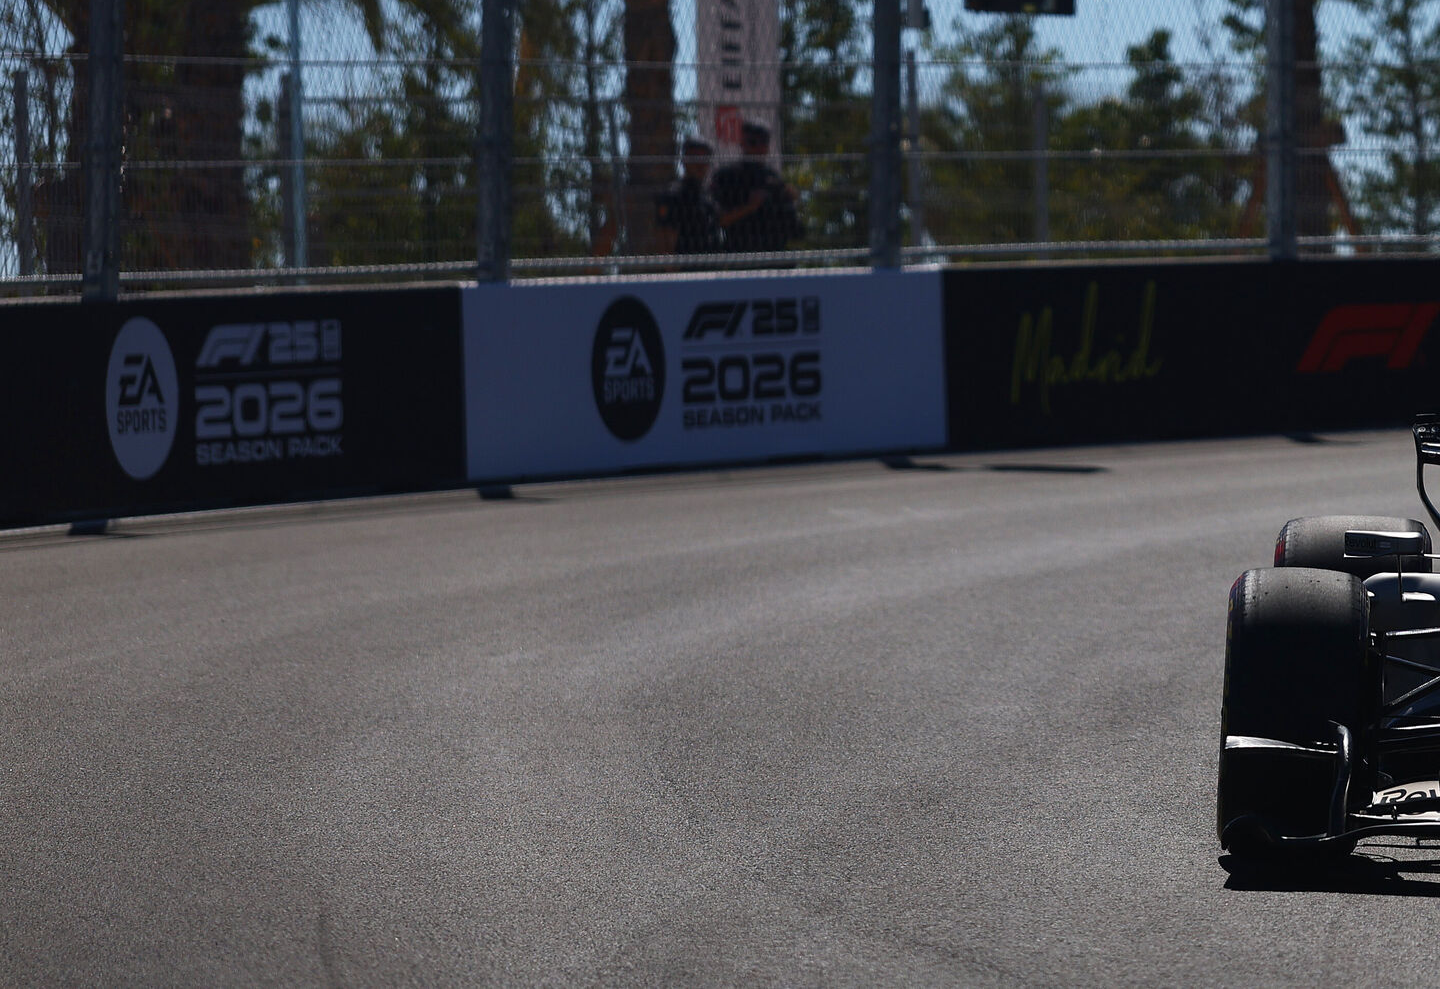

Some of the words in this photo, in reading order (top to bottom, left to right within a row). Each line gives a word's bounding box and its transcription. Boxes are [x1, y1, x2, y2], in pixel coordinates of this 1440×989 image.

[752, 298, 797, 335] 25
[268, 319, 319, 365] 25
[605, 327, 653, 376] EA
[1010, 279, 1165, 414] Madrid
[119, 354, 165, 406] EA
[603, 376, 656, 404] SPORTS
[682, 353, 820, 403] 2026
[116, 408, 167, 435] SPORTS
[194, 378, 344, 440] 2026
[683, 405, 764, 430] SEASON
[771, 401, 821, 422] PACK
[196, 438, 283, 466] SEASON
[287, 434, 344, 458] PACK
